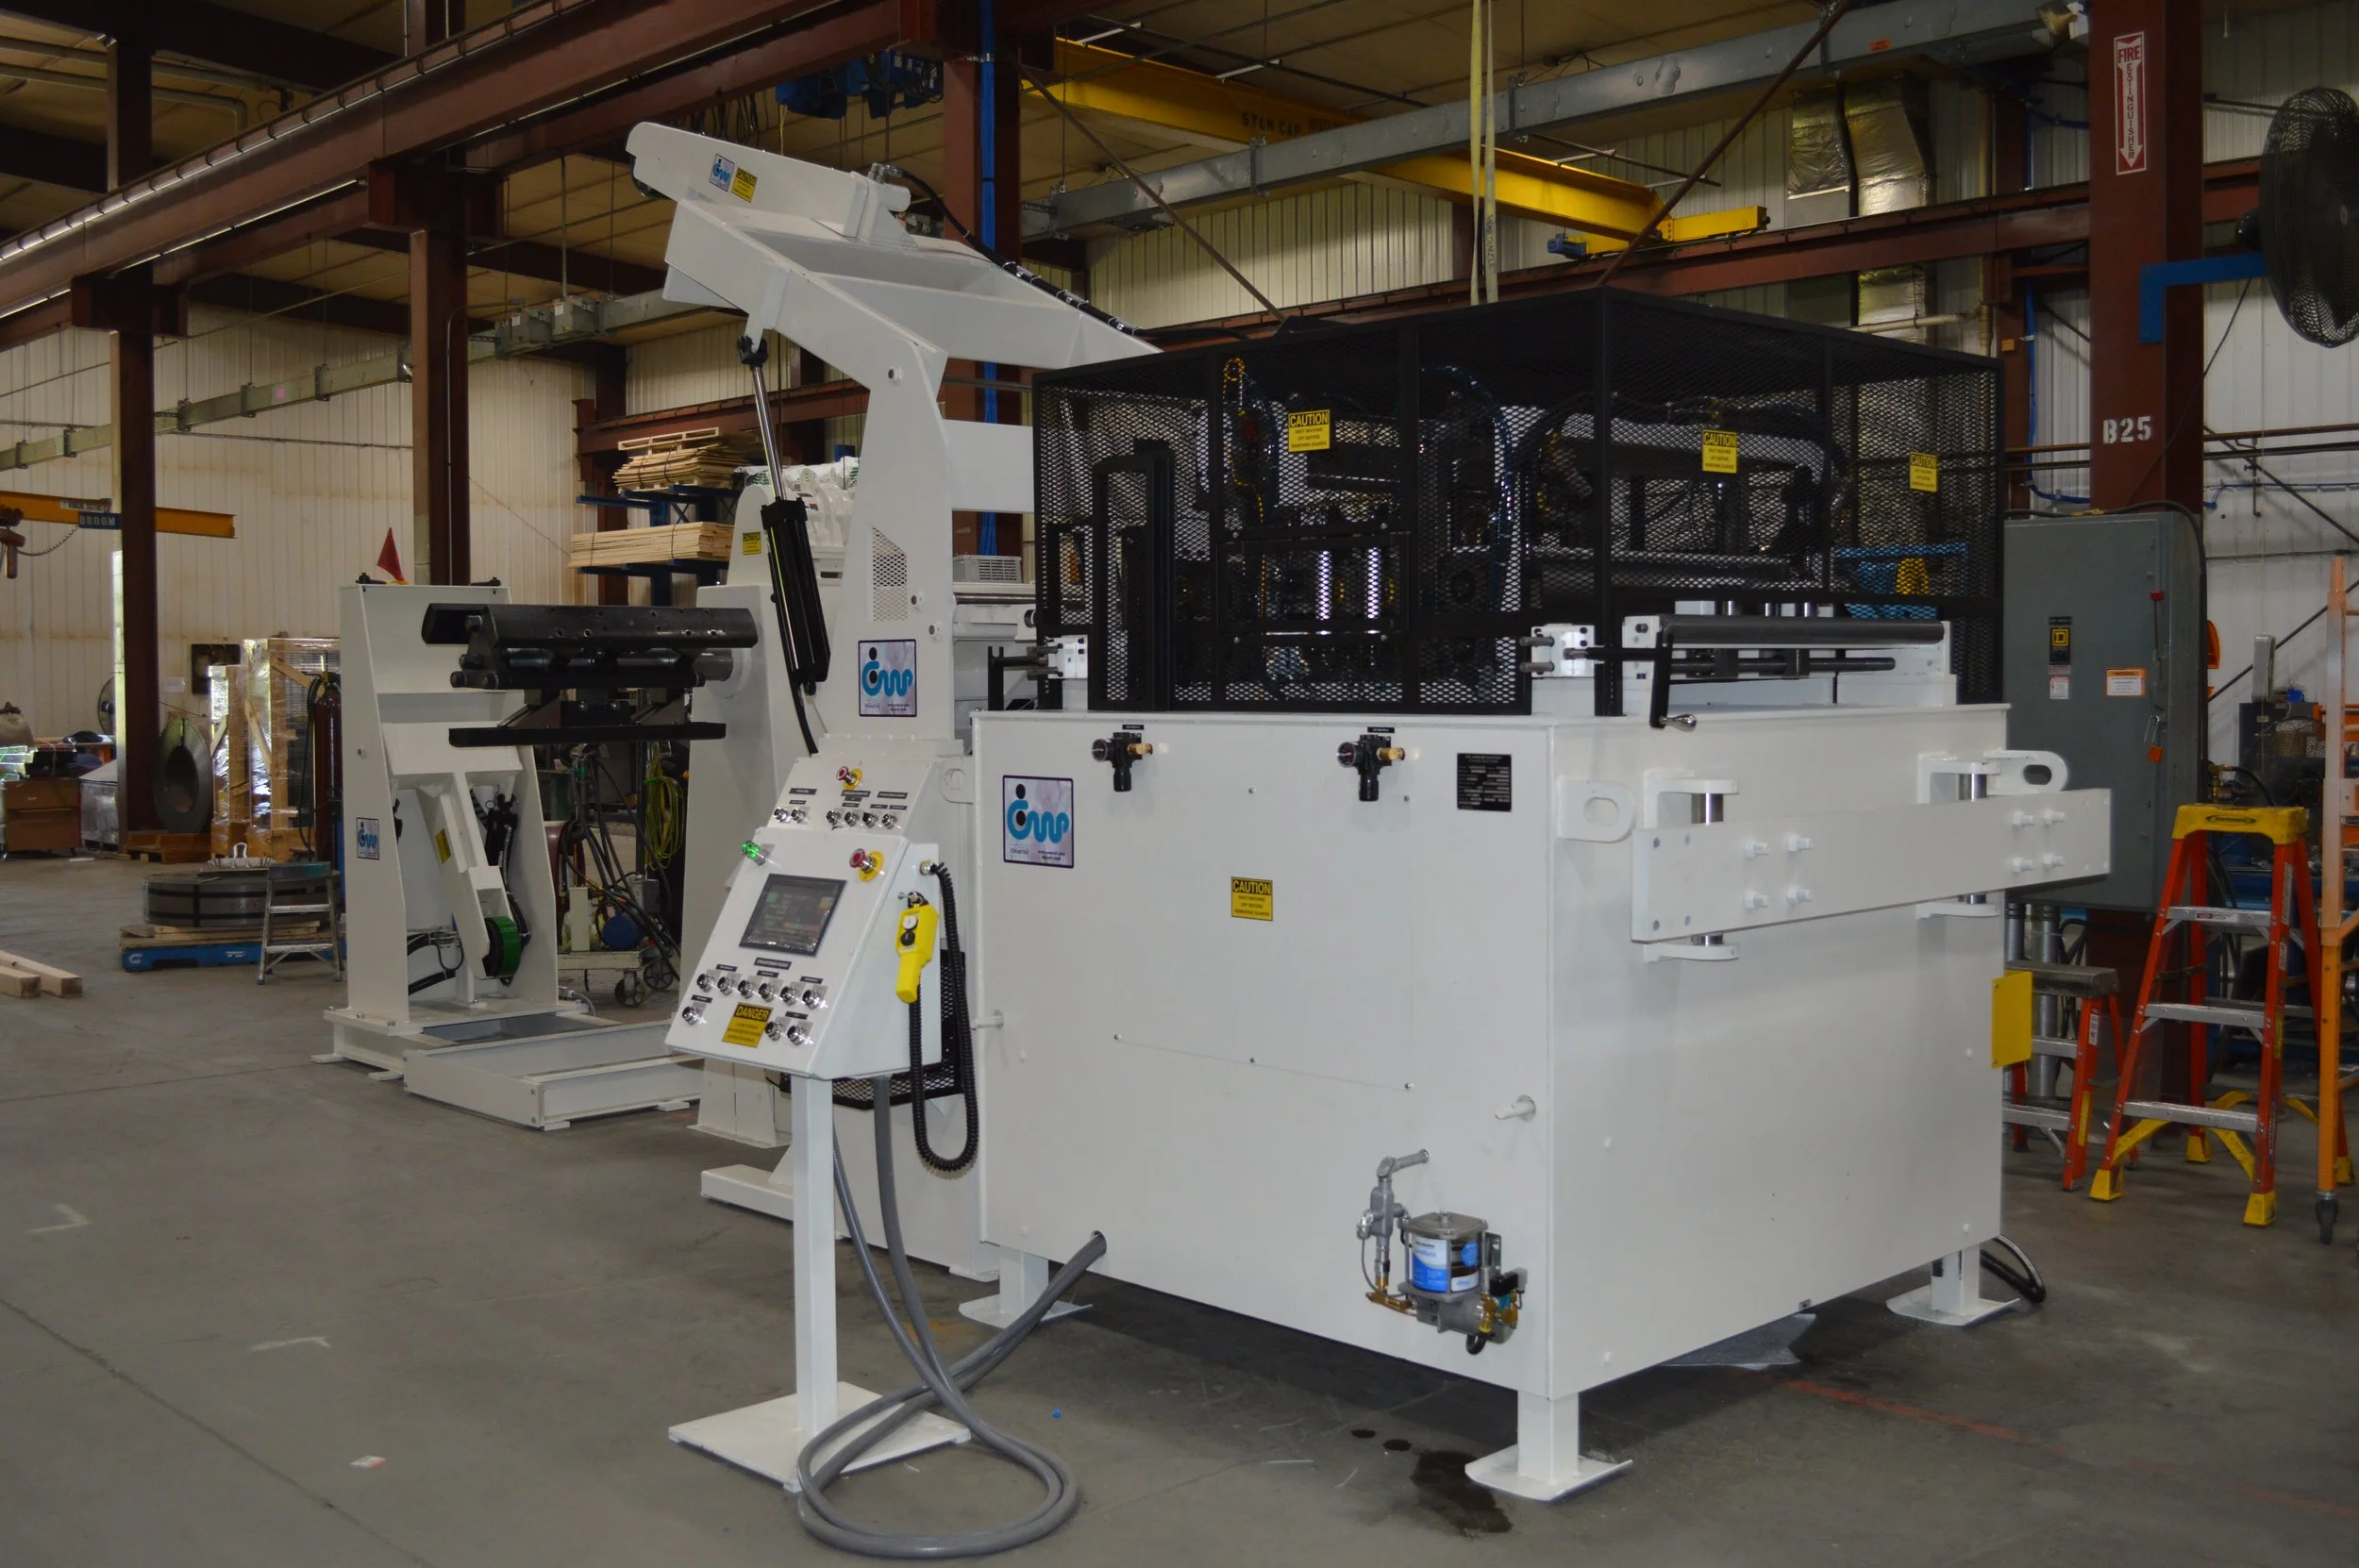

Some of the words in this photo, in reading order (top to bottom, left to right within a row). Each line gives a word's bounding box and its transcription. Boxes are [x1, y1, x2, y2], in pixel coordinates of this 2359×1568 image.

[2117, 45, 2141, 63] FIRE
[2126, 63, 2135, 159] EXTINGUISHER
[1289, 411, 1329, 427] CAUTION
[2102, 415, 2151, 444] B25
[1704, 432, 1736, 447] CAUTION
[1911, 454, 1936, 469] CAUTION
[79, 514, 116, 526] BROOM
[1232, 879, 1271, 894] CAUTION
[735, 1005, 770, 1022] DANGER
